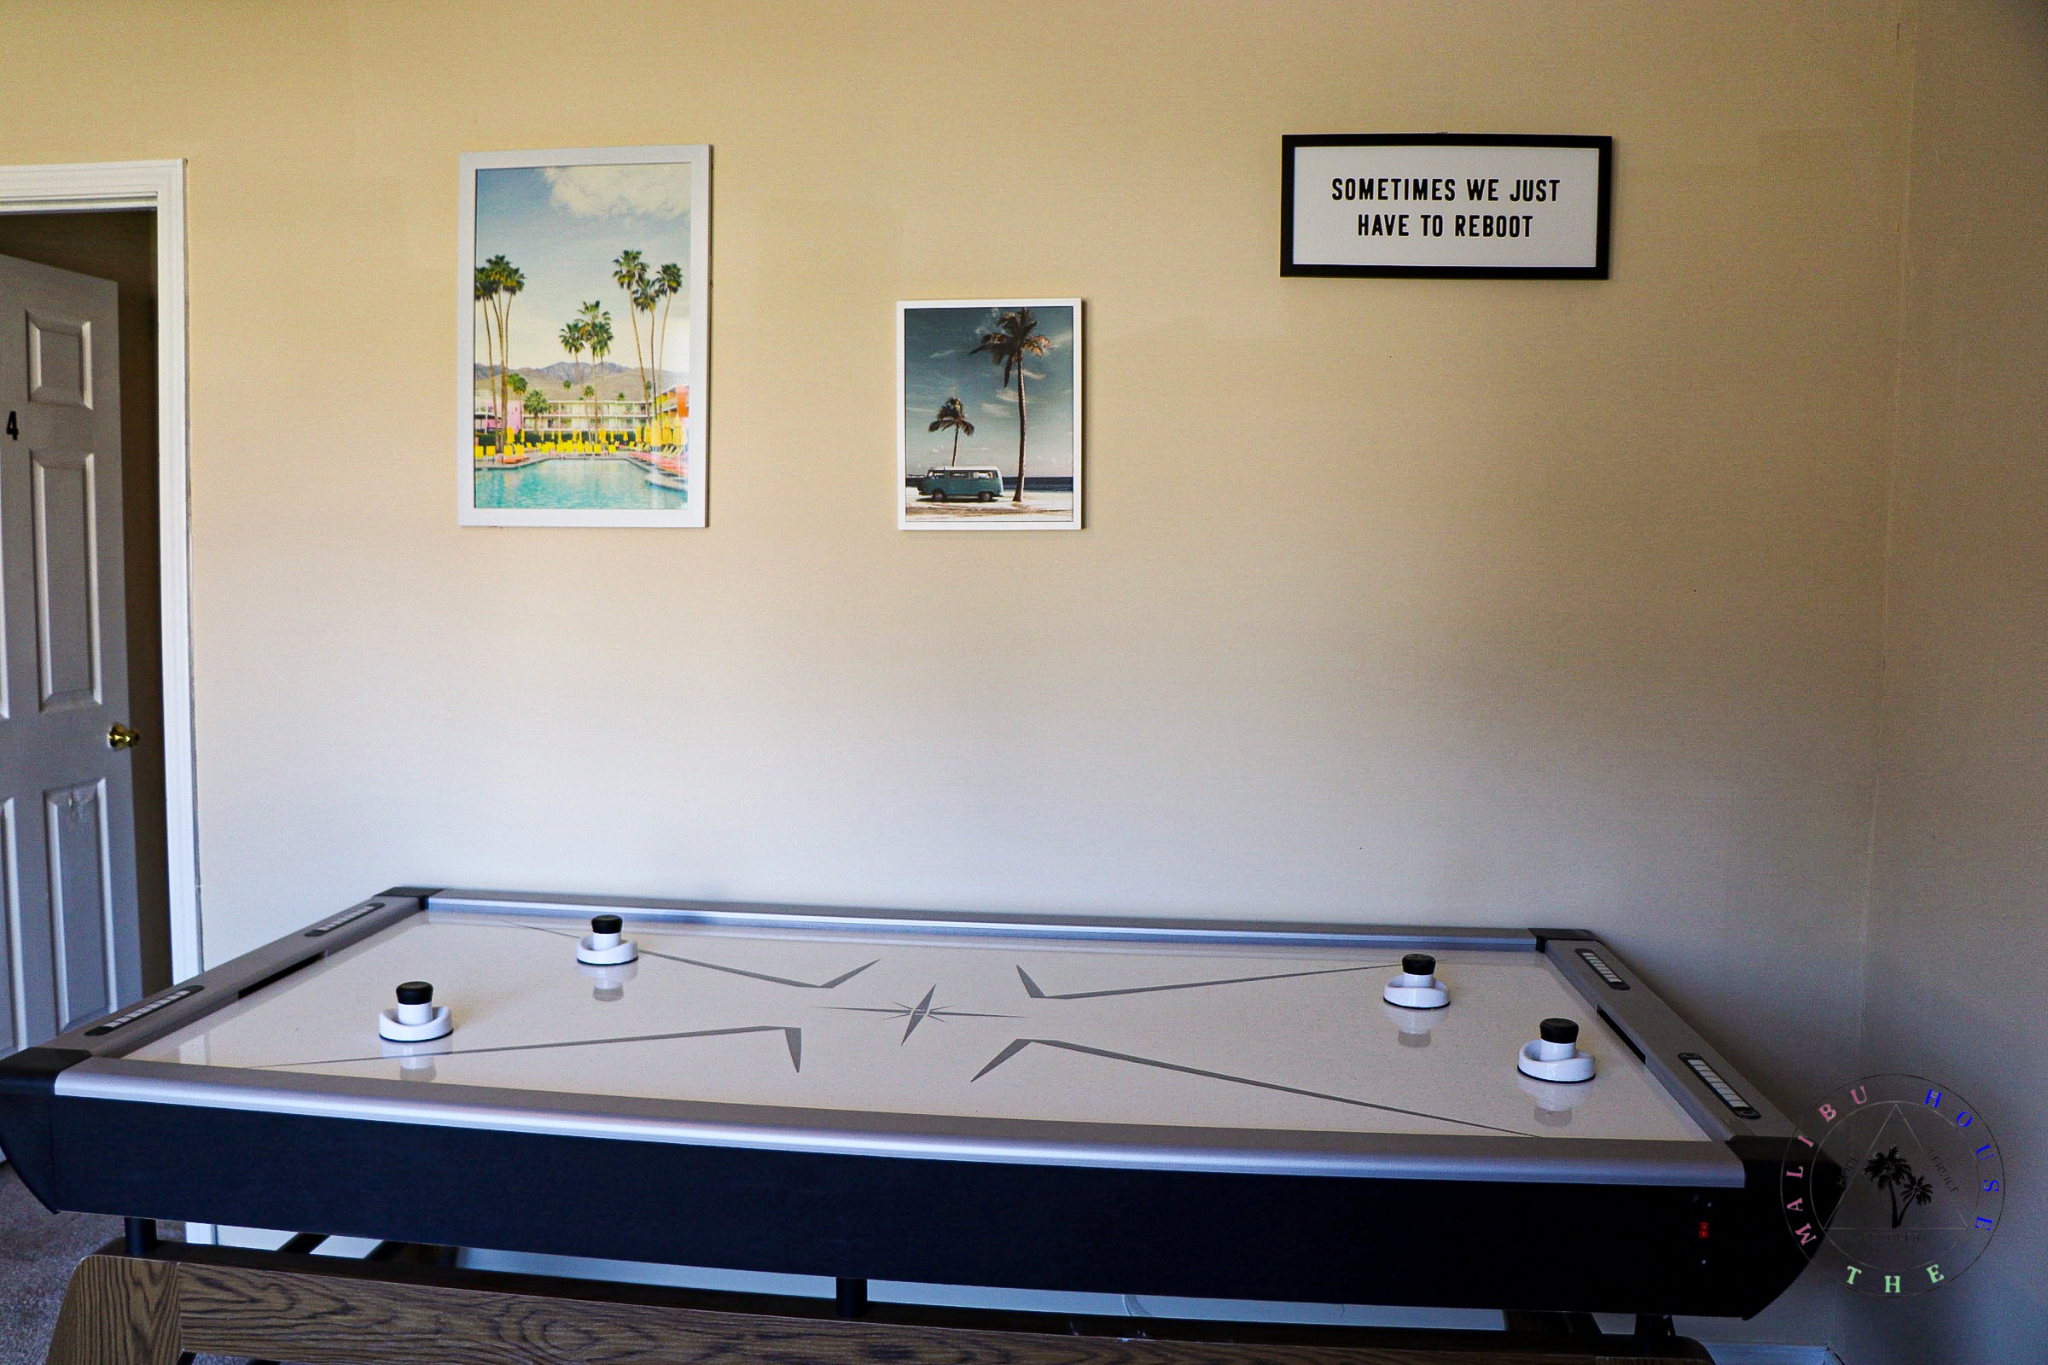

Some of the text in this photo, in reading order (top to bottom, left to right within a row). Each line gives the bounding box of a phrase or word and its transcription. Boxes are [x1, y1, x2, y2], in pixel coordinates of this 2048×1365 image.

[1331, 178, 1561, 202] SOMETIMES WE JUST
[1358, 214, 1534, 238] HAVE TO REBOOT
[6, 410, 19, 441] 4
